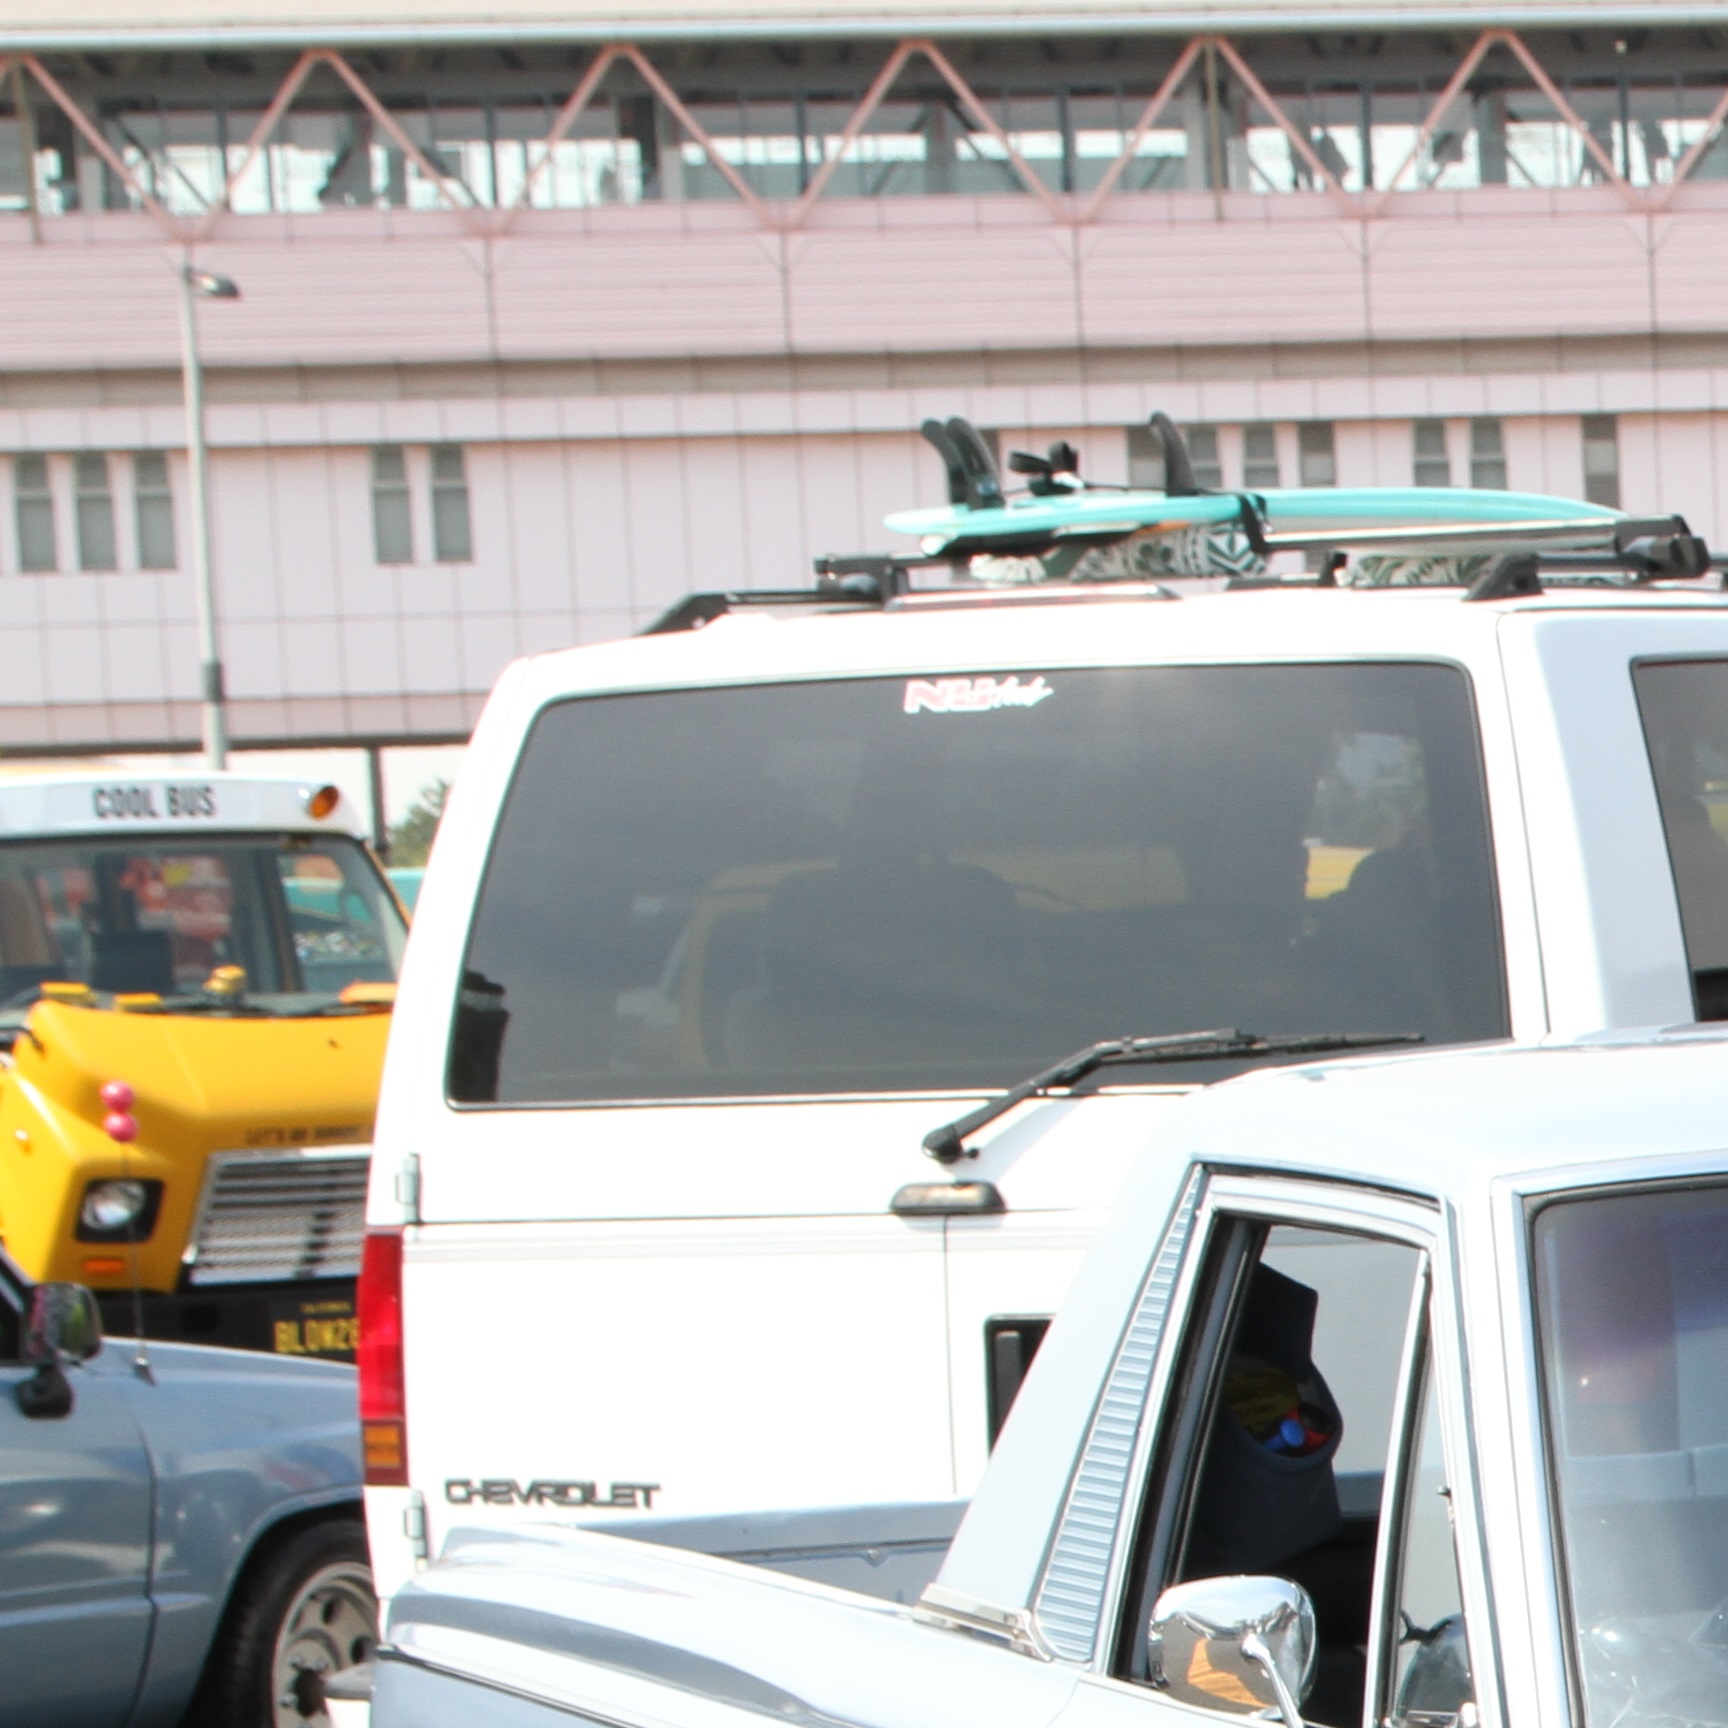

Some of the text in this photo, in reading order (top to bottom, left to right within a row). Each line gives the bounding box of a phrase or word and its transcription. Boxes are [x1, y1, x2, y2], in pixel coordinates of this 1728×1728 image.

[95, 785, 214, 818] COOL BUS
[445, 1479, 661, 1509] CHEVROLET
